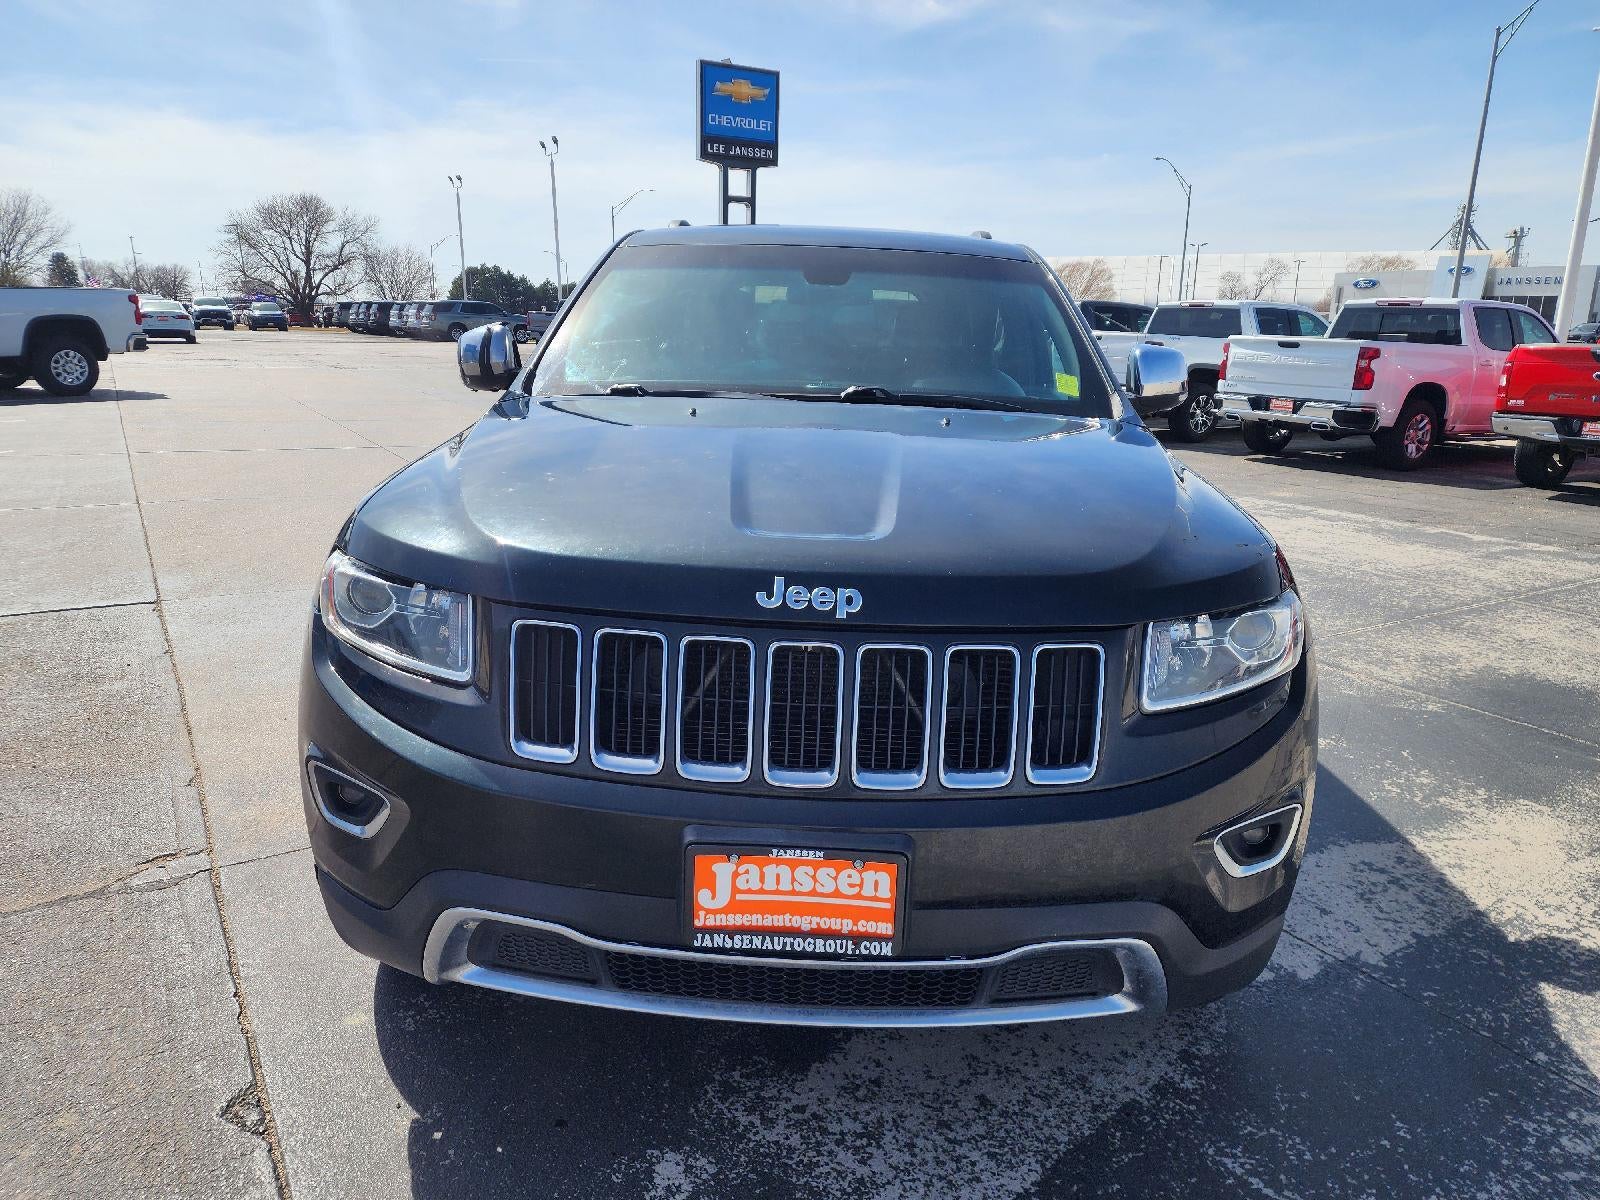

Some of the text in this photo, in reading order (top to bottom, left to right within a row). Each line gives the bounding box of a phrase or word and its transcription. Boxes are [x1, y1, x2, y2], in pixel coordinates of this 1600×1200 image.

[709, 113, 772, 131] CHEVROLET
[708, 143, 773, 159] LEE JANSSEN
[1497, 276, 1563, 286] JANSSEN
[755, 576, 863, 619] Jeep
[769, 849, 825, 859] JANSSEN
[698, 862, 892, 909] Janssen
[695, 910, 893, 935] Janssenautogroup.com
